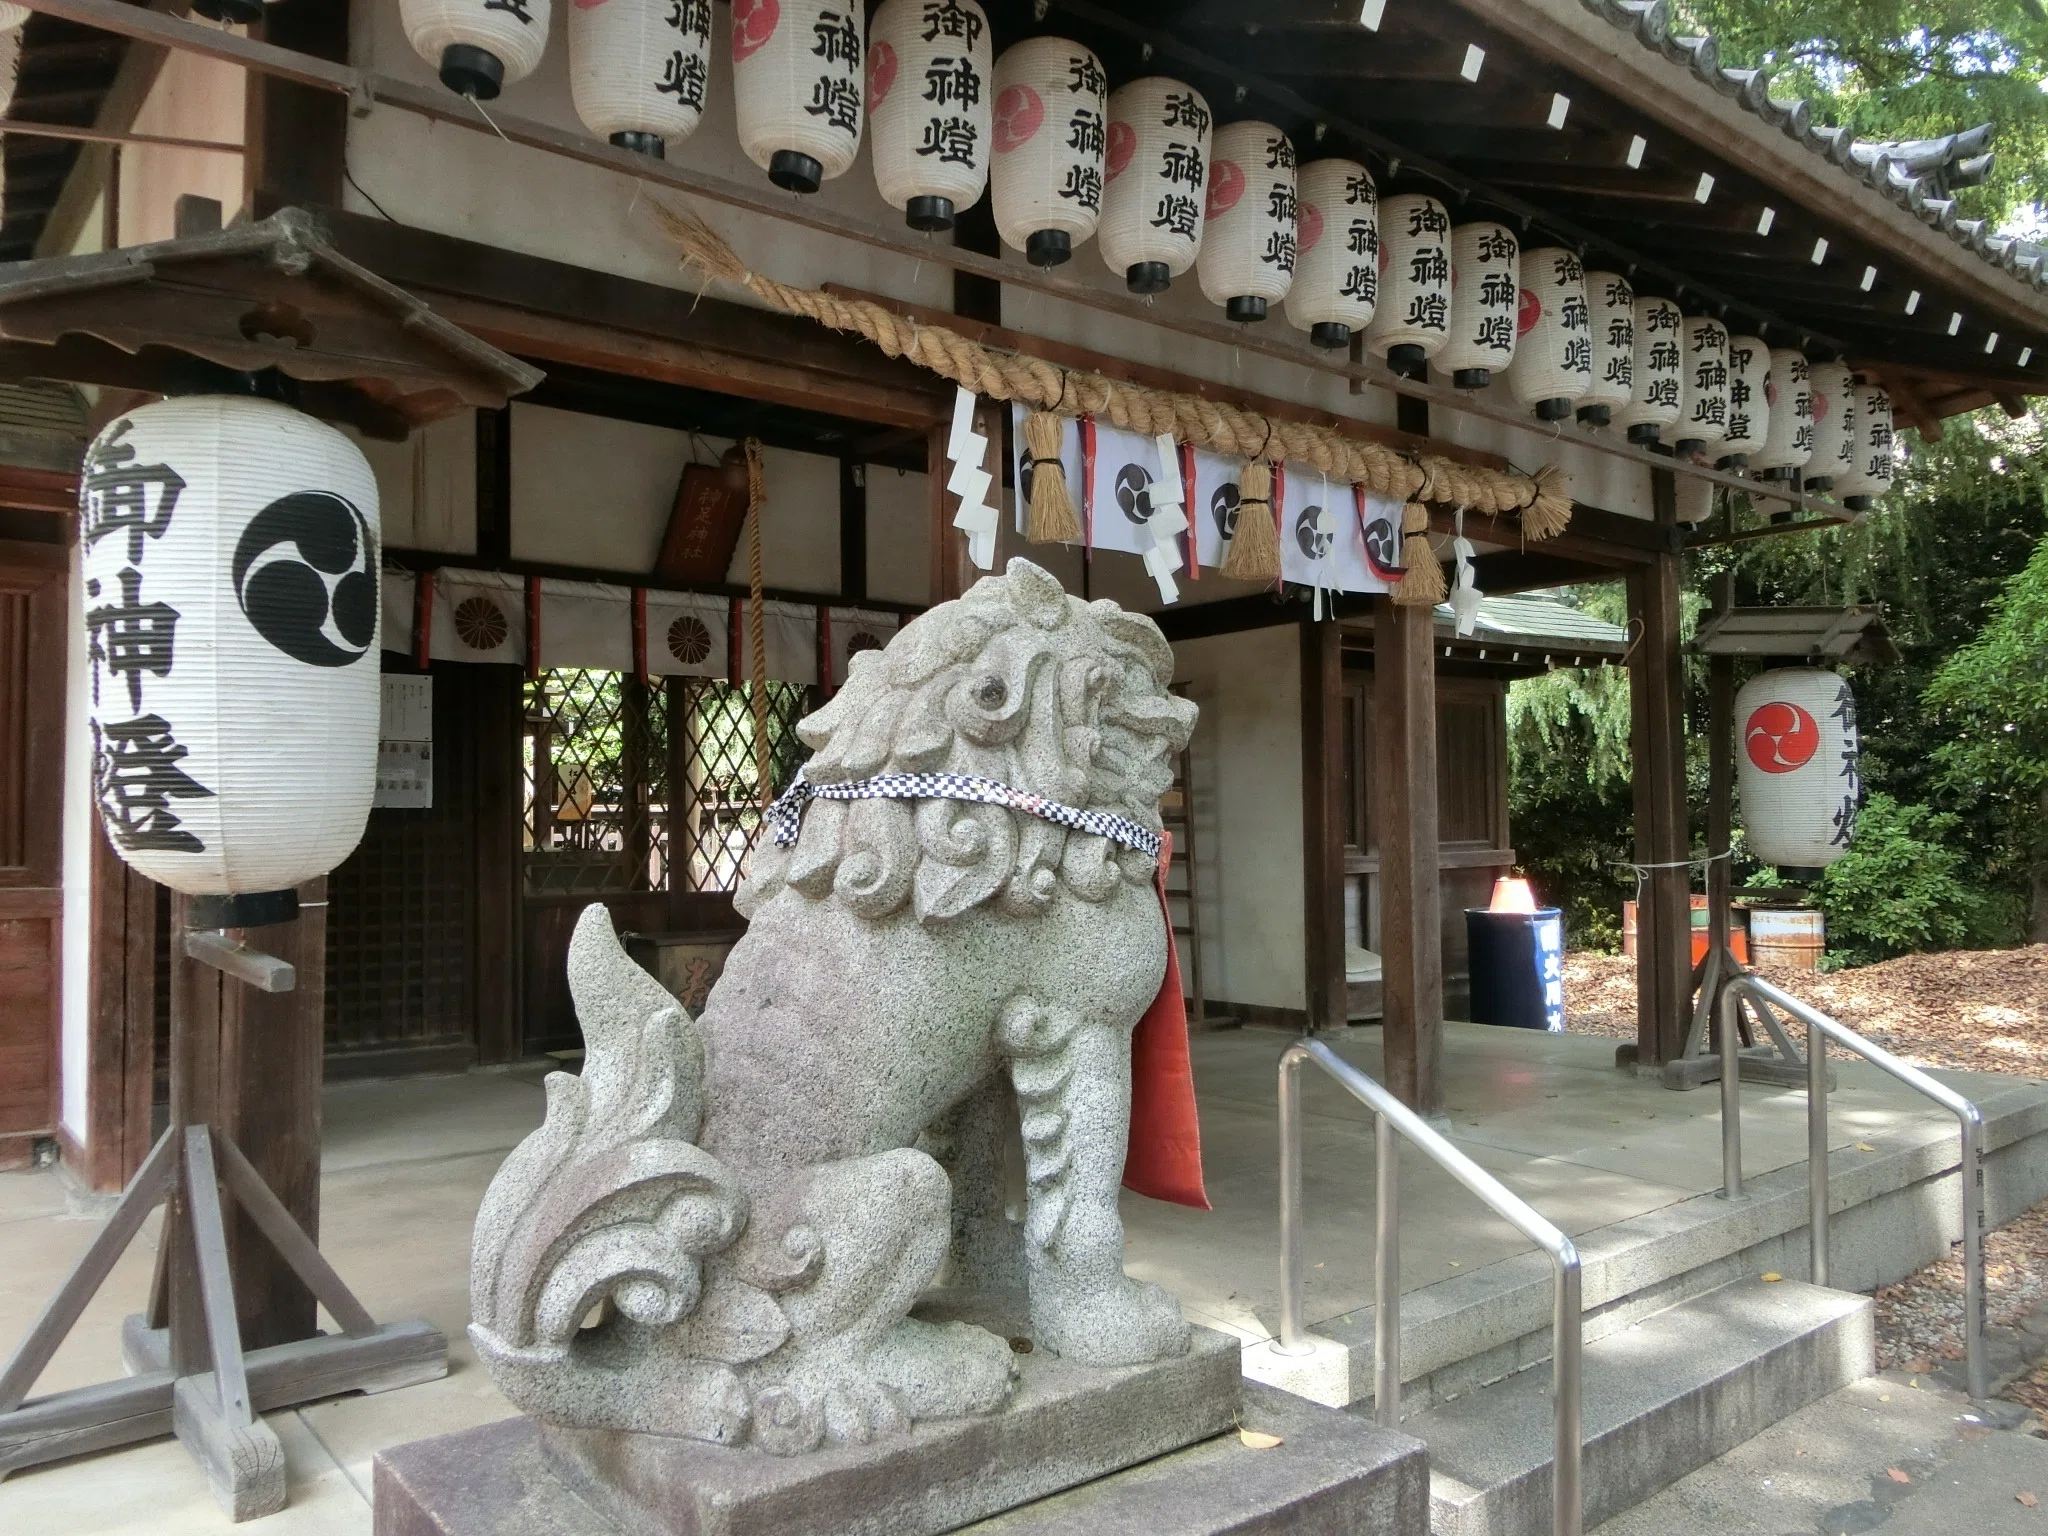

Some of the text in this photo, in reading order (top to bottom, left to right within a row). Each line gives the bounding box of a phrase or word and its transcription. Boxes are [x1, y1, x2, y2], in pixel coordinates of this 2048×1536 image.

[804, 0, 862, 139] 神燈
[915, 1, 983, 170] 御神燈
[1058, 55, 1106, 217] 御神燈
[1150, 92, 1209, 243] 御神燈
[1261, 135, 1298, 279] 御神燈
[1340, 173, 1377, 309] 御神燈
[1404, 200, 1448, 331] 御神燈
[1473, 229, 1516, 353] 御神燈
[1554, 255, 1591, 374] 御神燈
[1603, 279, 1634, 389] 御神燈
[1645, 303, 1680, 409] 御神燈
[1690, 323, 1727, 426] 御神燈
[1866, 394, 1892, 482] 御神燈
[80, 417, 218, 854] 御神燈
